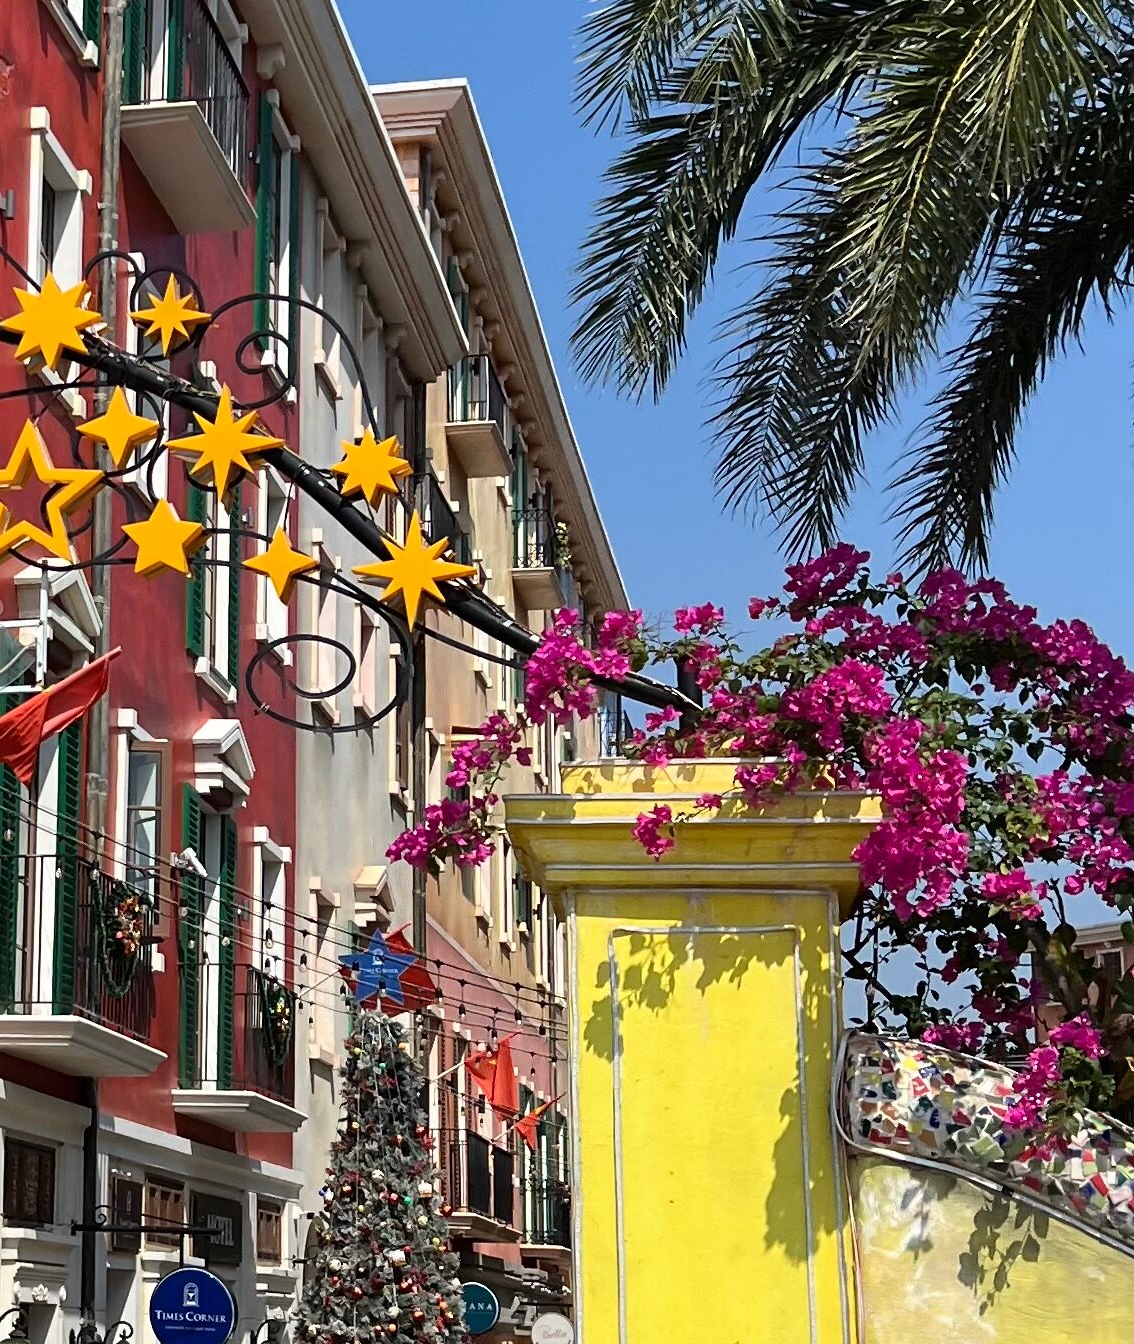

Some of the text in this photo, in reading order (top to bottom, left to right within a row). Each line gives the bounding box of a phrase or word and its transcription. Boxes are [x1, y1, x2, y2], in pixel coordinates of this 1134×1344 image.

[468, 1302, 493, 1311] ANA
[155, 1310, 227, 1323] TIMES CORNER
